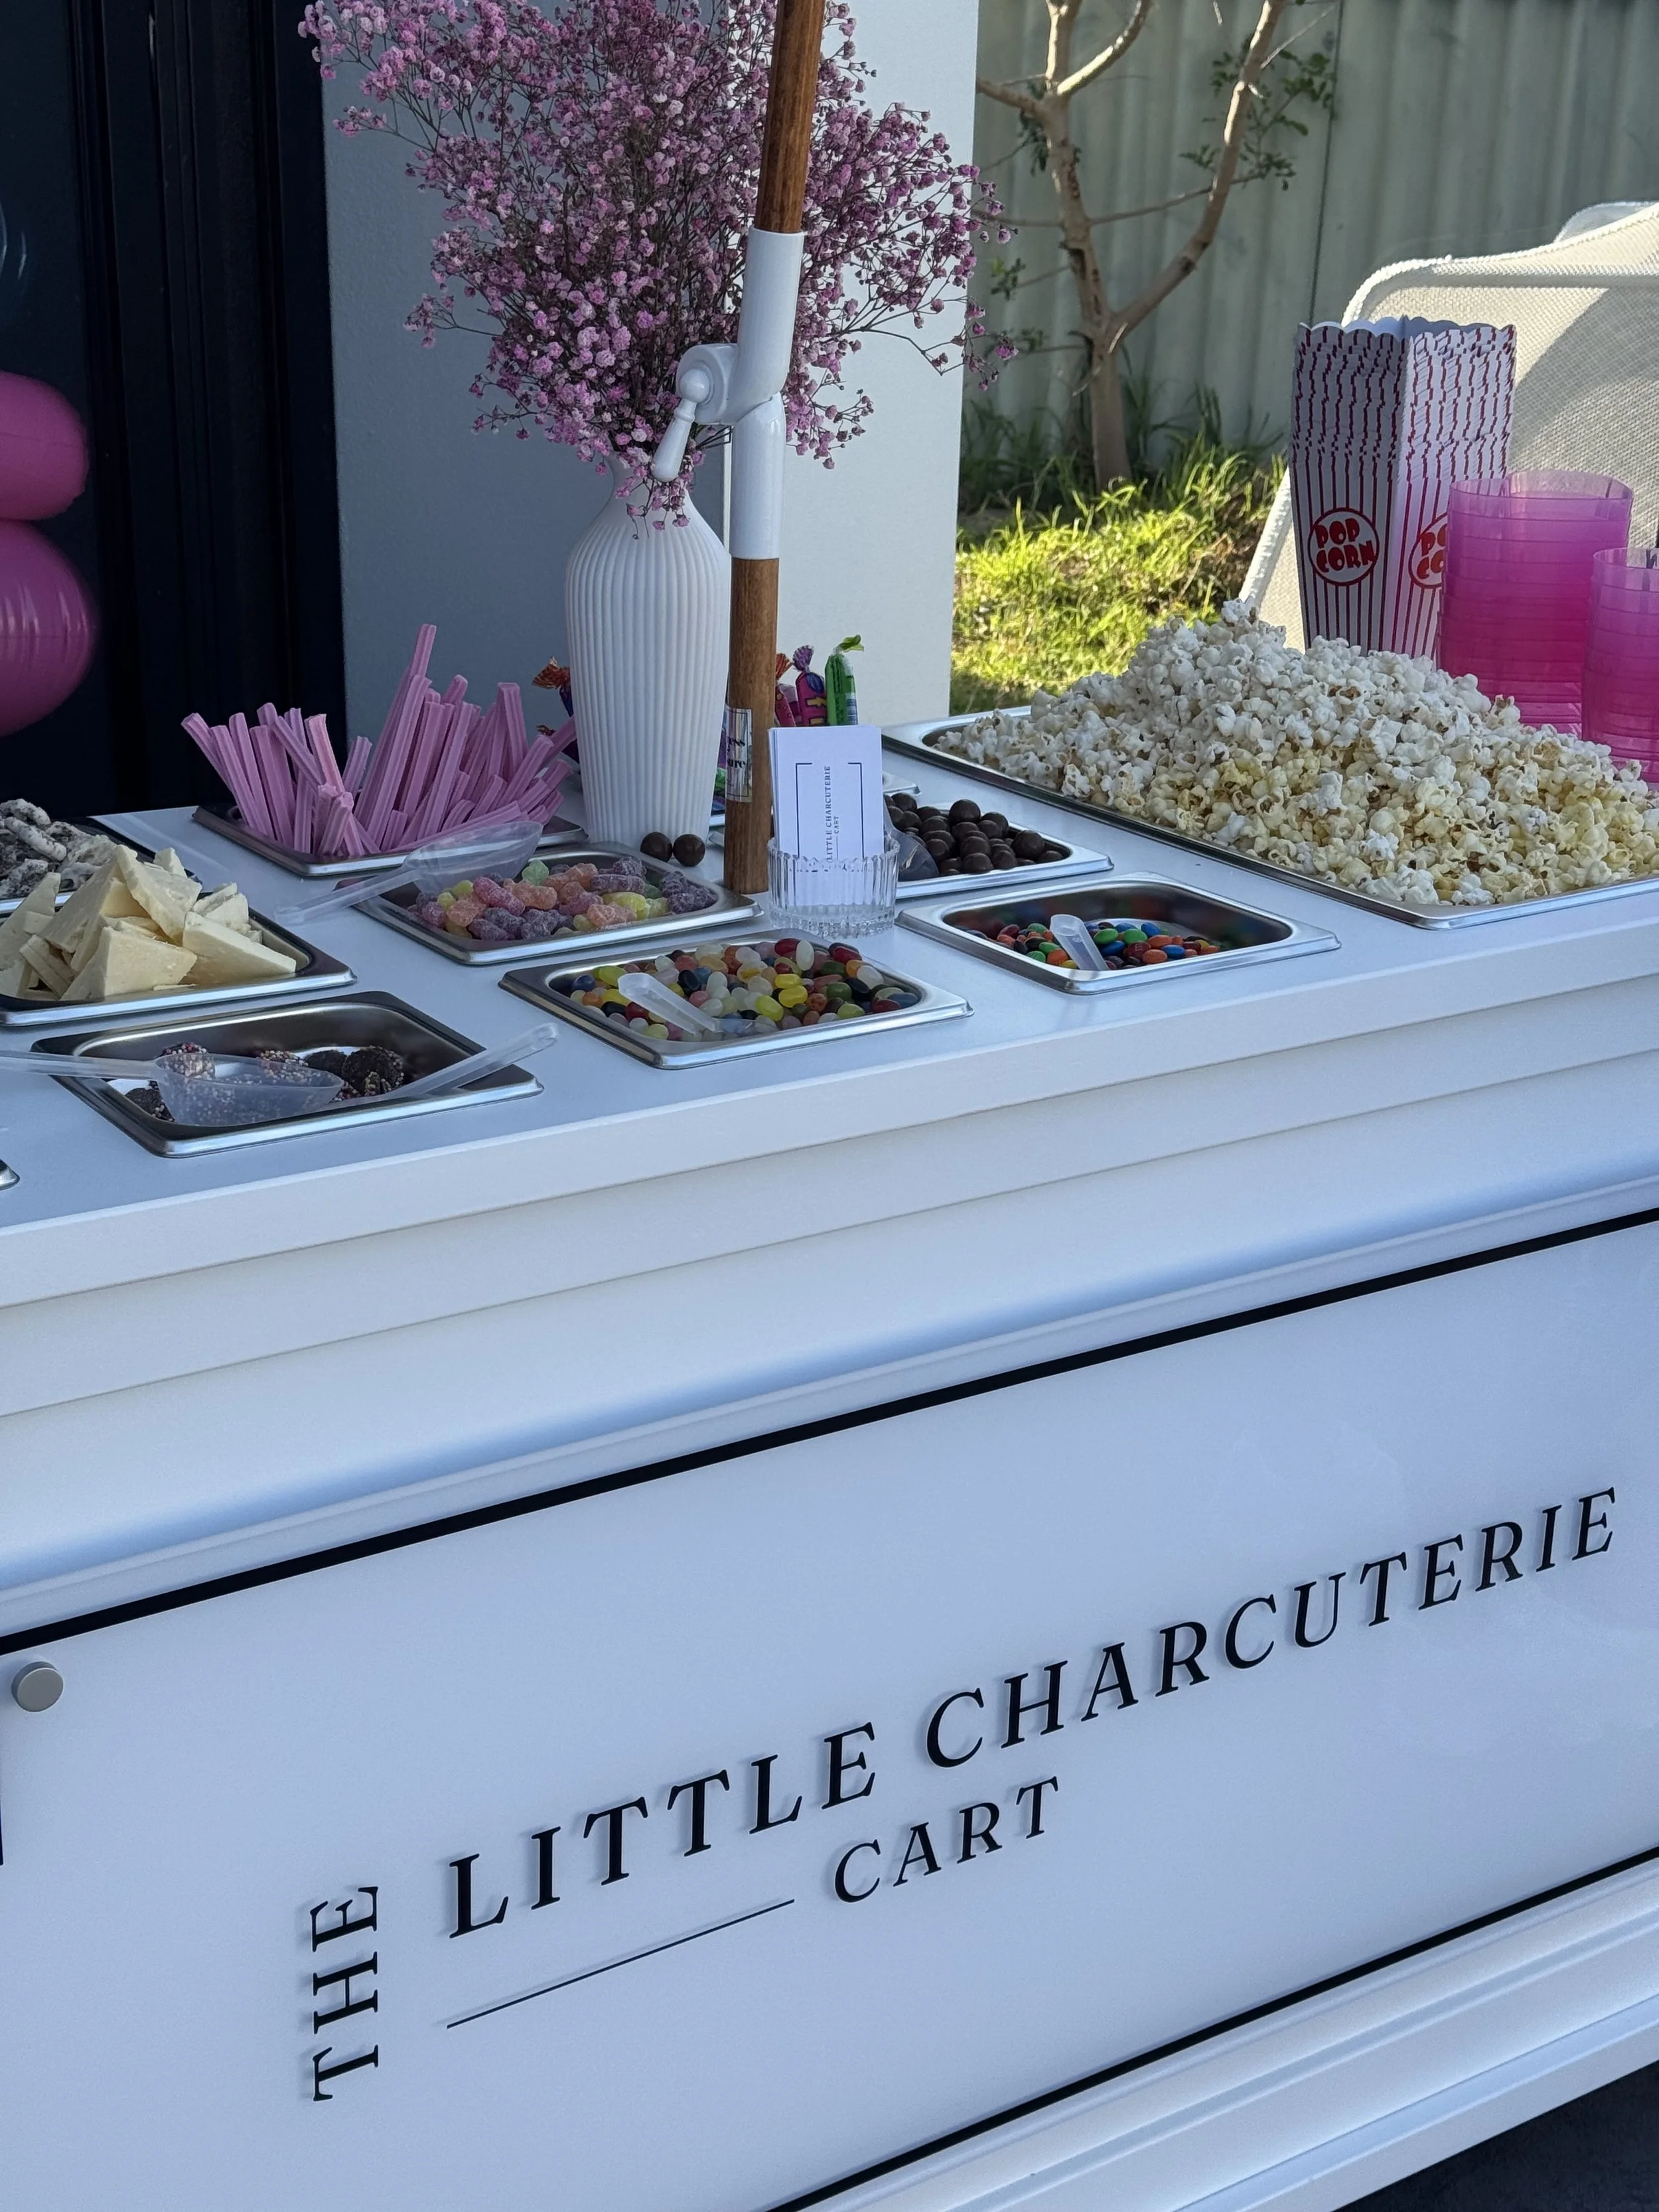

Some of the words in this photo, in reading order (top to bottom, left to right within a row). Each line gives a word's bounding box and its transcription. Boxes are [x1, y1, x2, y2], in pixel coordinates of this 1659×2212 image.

[1314, 518, 1360, 548] POP
[1421, 524, 1447, 556] PO
[1317, 540, 1375, 573] CORN
[1417, 550, 1444, 579] CO
[448, 1721, 876, 1939] LITTLE
[926, 1486, 1616, 1769] CHARCUTERIE
[834, 1775, 1059, 1903] CART
[309, 1885, 379, 2102] THE
